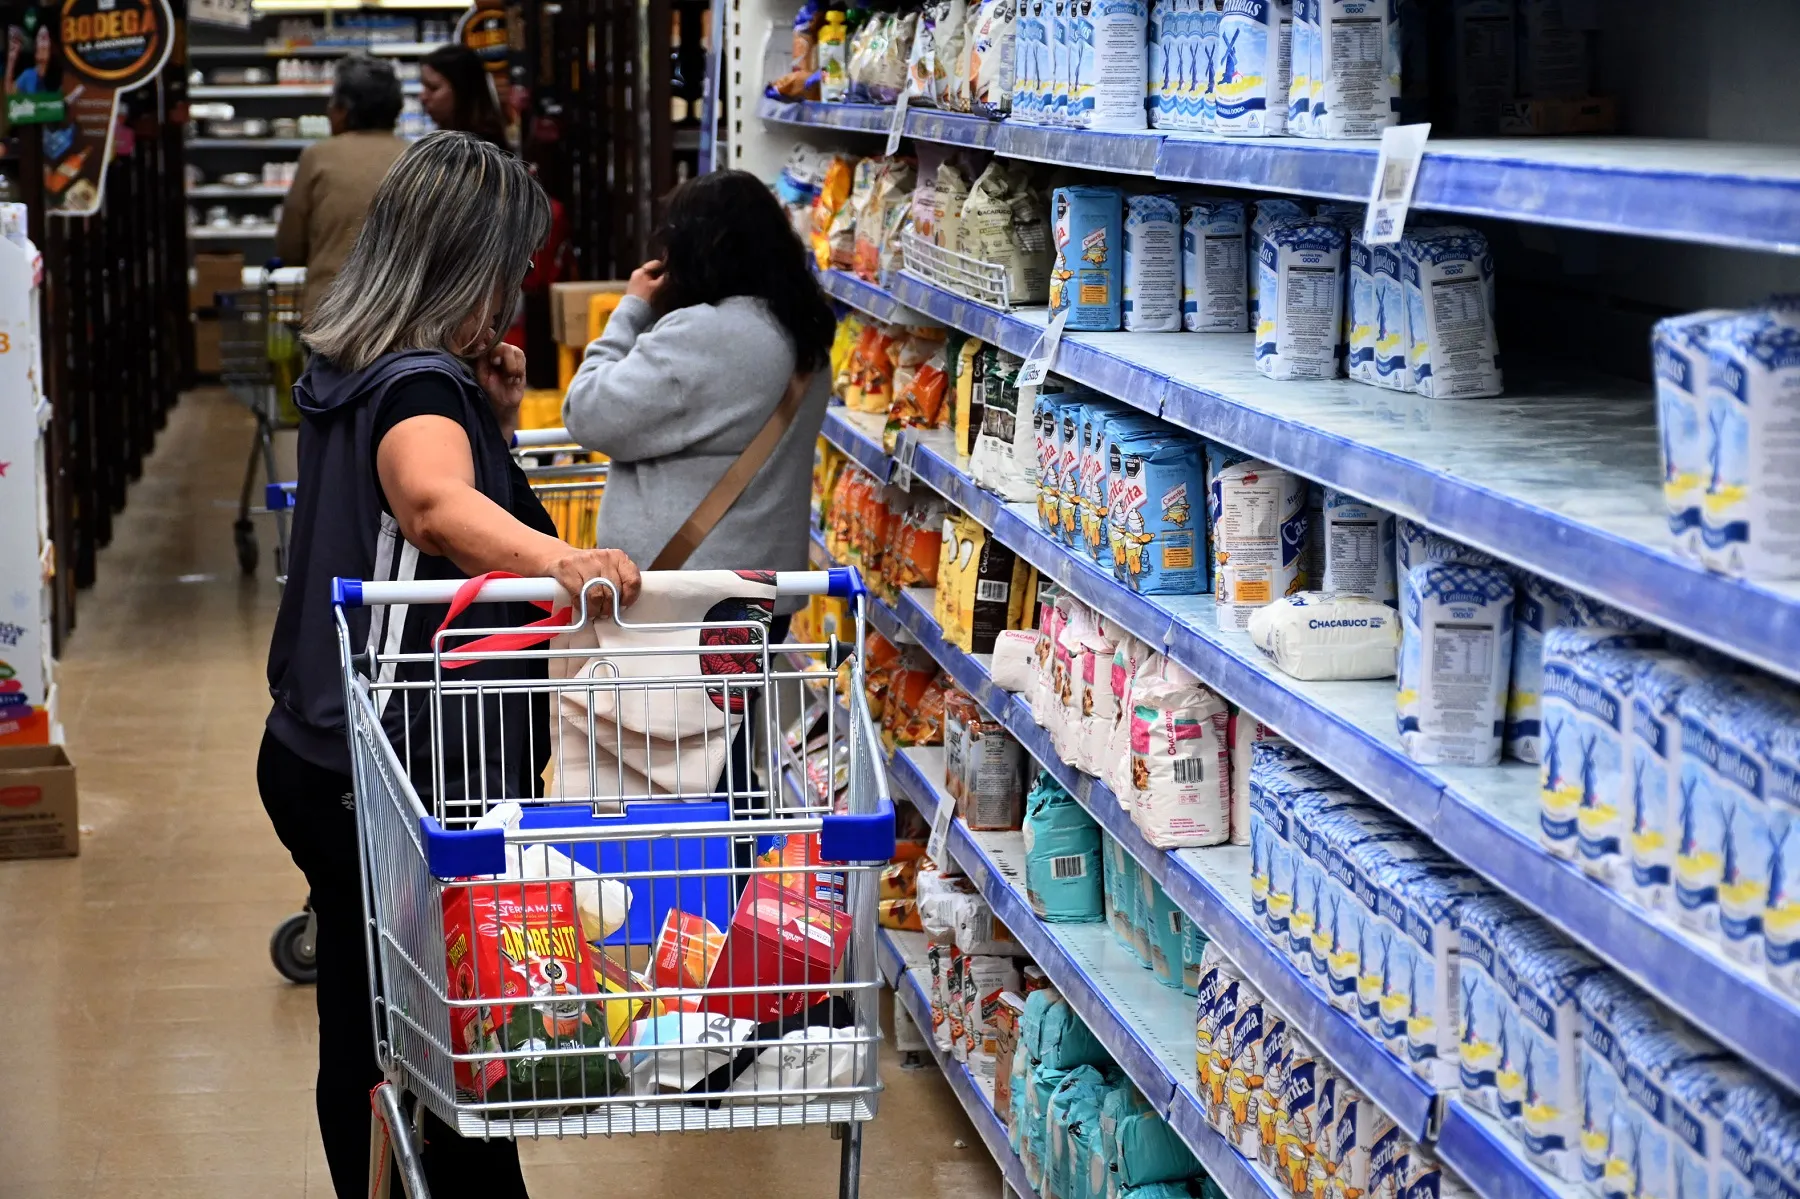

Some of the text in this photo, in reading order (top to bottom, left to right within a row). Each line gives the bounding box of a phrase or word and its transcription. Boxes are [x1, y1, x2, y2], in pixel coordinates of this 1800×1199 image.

[62, 9, 157, 41] BODEGA
[1295, 242, 1328, 251] Cañuelas
[1434, 250, 1469, 264] Cañuelas
[1444, 267, 1463, 275] 0000
[1162, 488, 1186, 506] Caserita
[1443, 592, 1484, 604] Cañuelas
[1308, 618, 1368, 629] CHACABUCO
[1167, 709, 1177, 756] CHACABUCO
[503, 925, 583, 964] ANDRESITO
